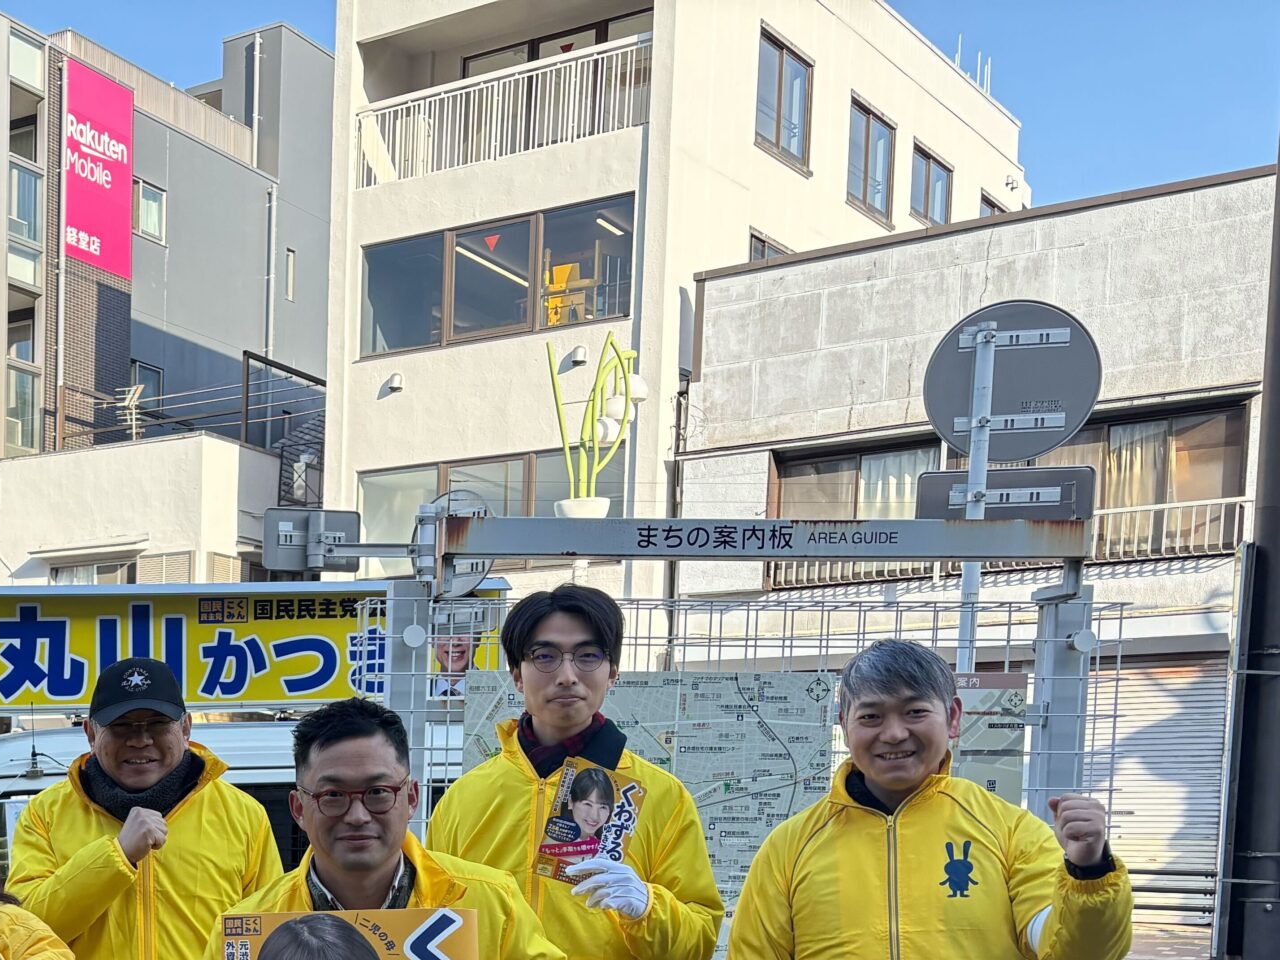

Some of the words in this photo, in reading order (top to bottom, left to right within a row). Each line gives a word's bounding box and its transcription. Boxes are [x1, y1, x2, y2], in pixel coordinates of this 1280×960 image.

[67, 113, 127, 164] Rakuten
[66, 148, 112, 188] Mobile
[66, 225, 101, 256] 経堂店
[637, 524, 794, 550] まちの案内板
[808, 532, 848, 545] AREA
[852, 531, 899, 545] GUIDE
[227, 601, 245, 609] こく
[227, 612, 246, 620] みん
[957, 677, 980, 688] 案内
[607, 784, 638, 862] くわずる
[244, 918, 258, 926] こく
[244, 926, 259, 934] みん
[359, 917, 396, 952] 二児の母
